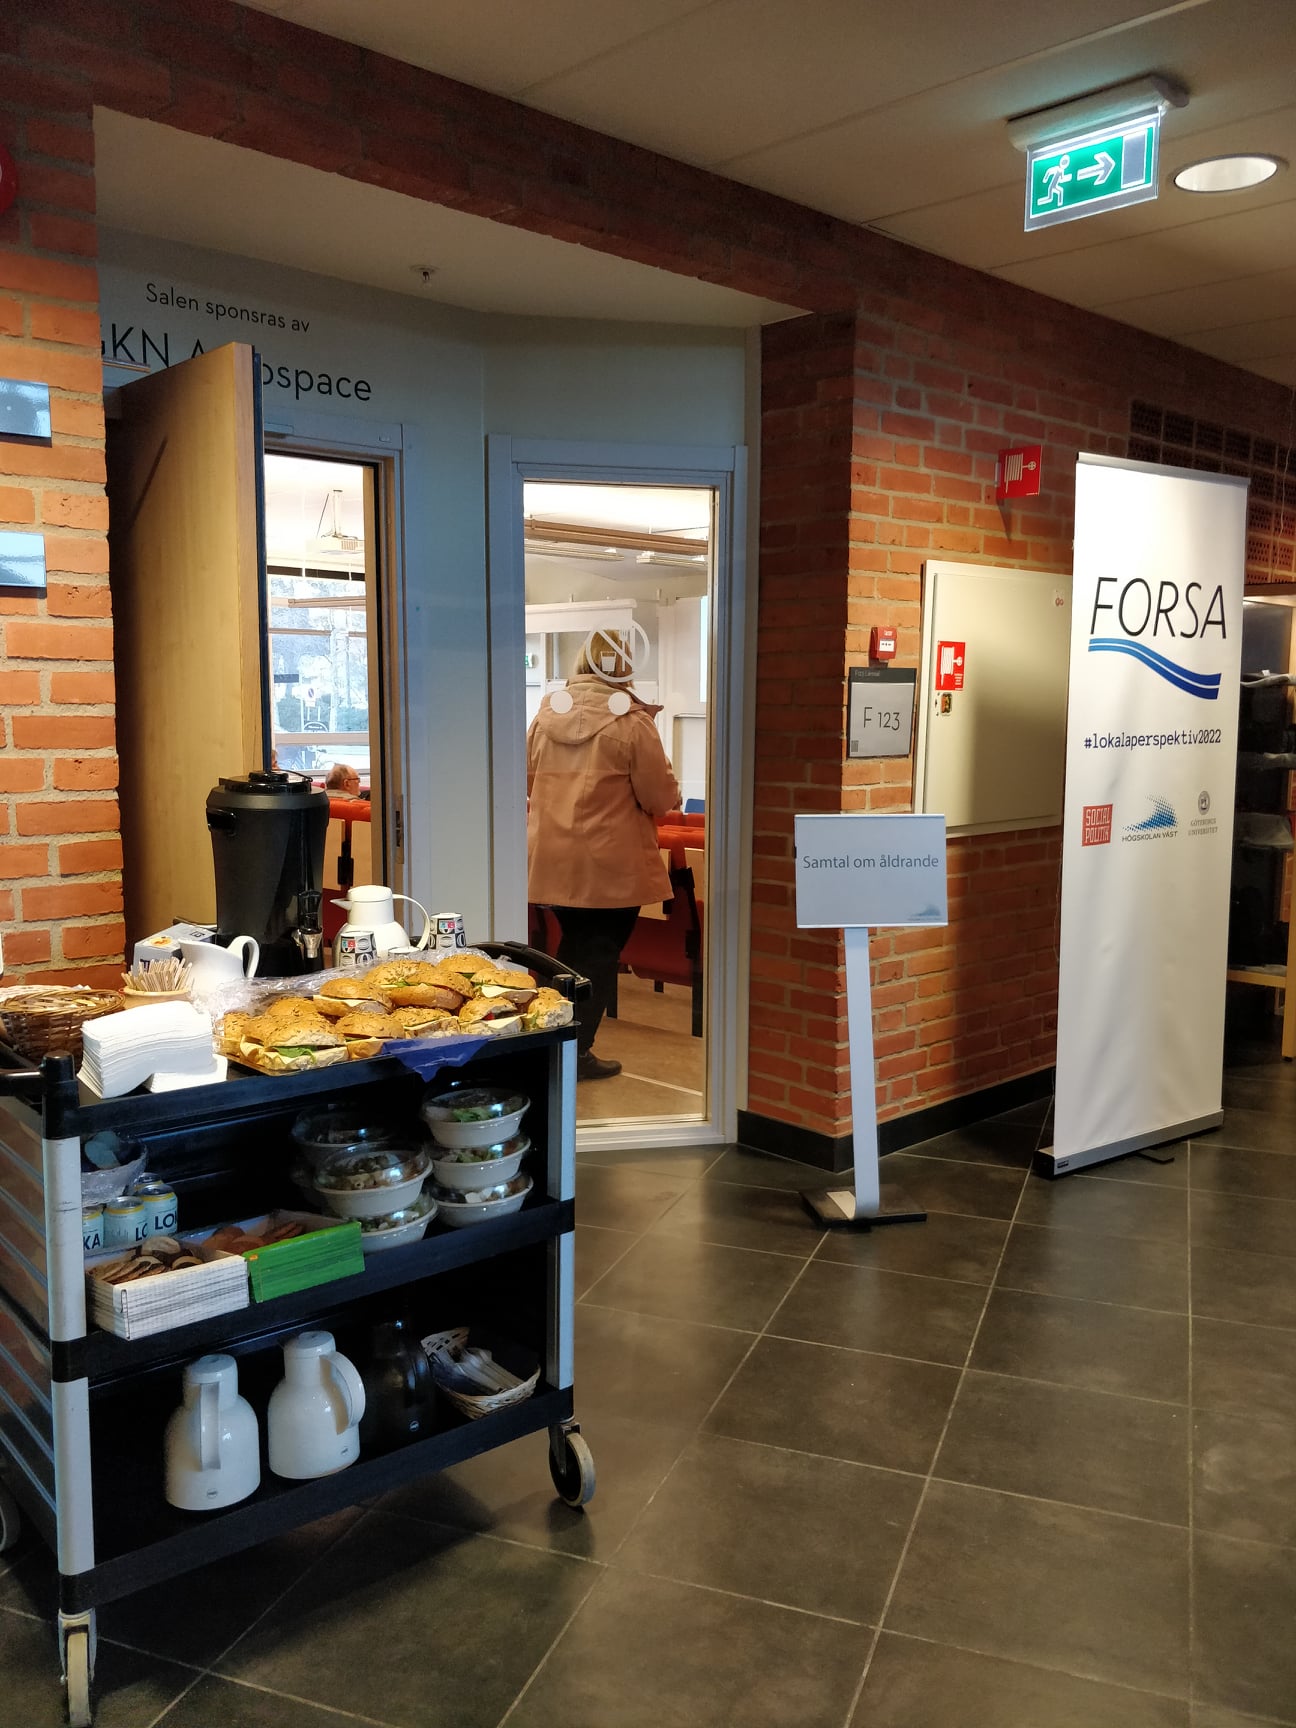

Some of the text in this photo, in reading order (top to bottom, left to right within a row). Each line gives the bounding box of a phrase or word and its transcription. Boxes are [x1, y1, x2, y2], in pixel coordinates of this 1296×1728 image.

[146, 283, 310, 333] Salen sponsras av
[101, 323, 170, 369] KN
[1090, 576, 1227, 639] FORSA
[863, 706, 900, 731] F 123
[1083, 728, 1222, 751] #lokalaperspektiv2022
[1085, 807, 1111, 826] SOCIAL
[1085, 826, 1110, 844] POLITIK
[1121, 830, 1178, 843] HÖGSKOLAN VÄST
[803, 853, 939, 869] Samtal om åldrande
[154, 1210, 177, 1231] LO
